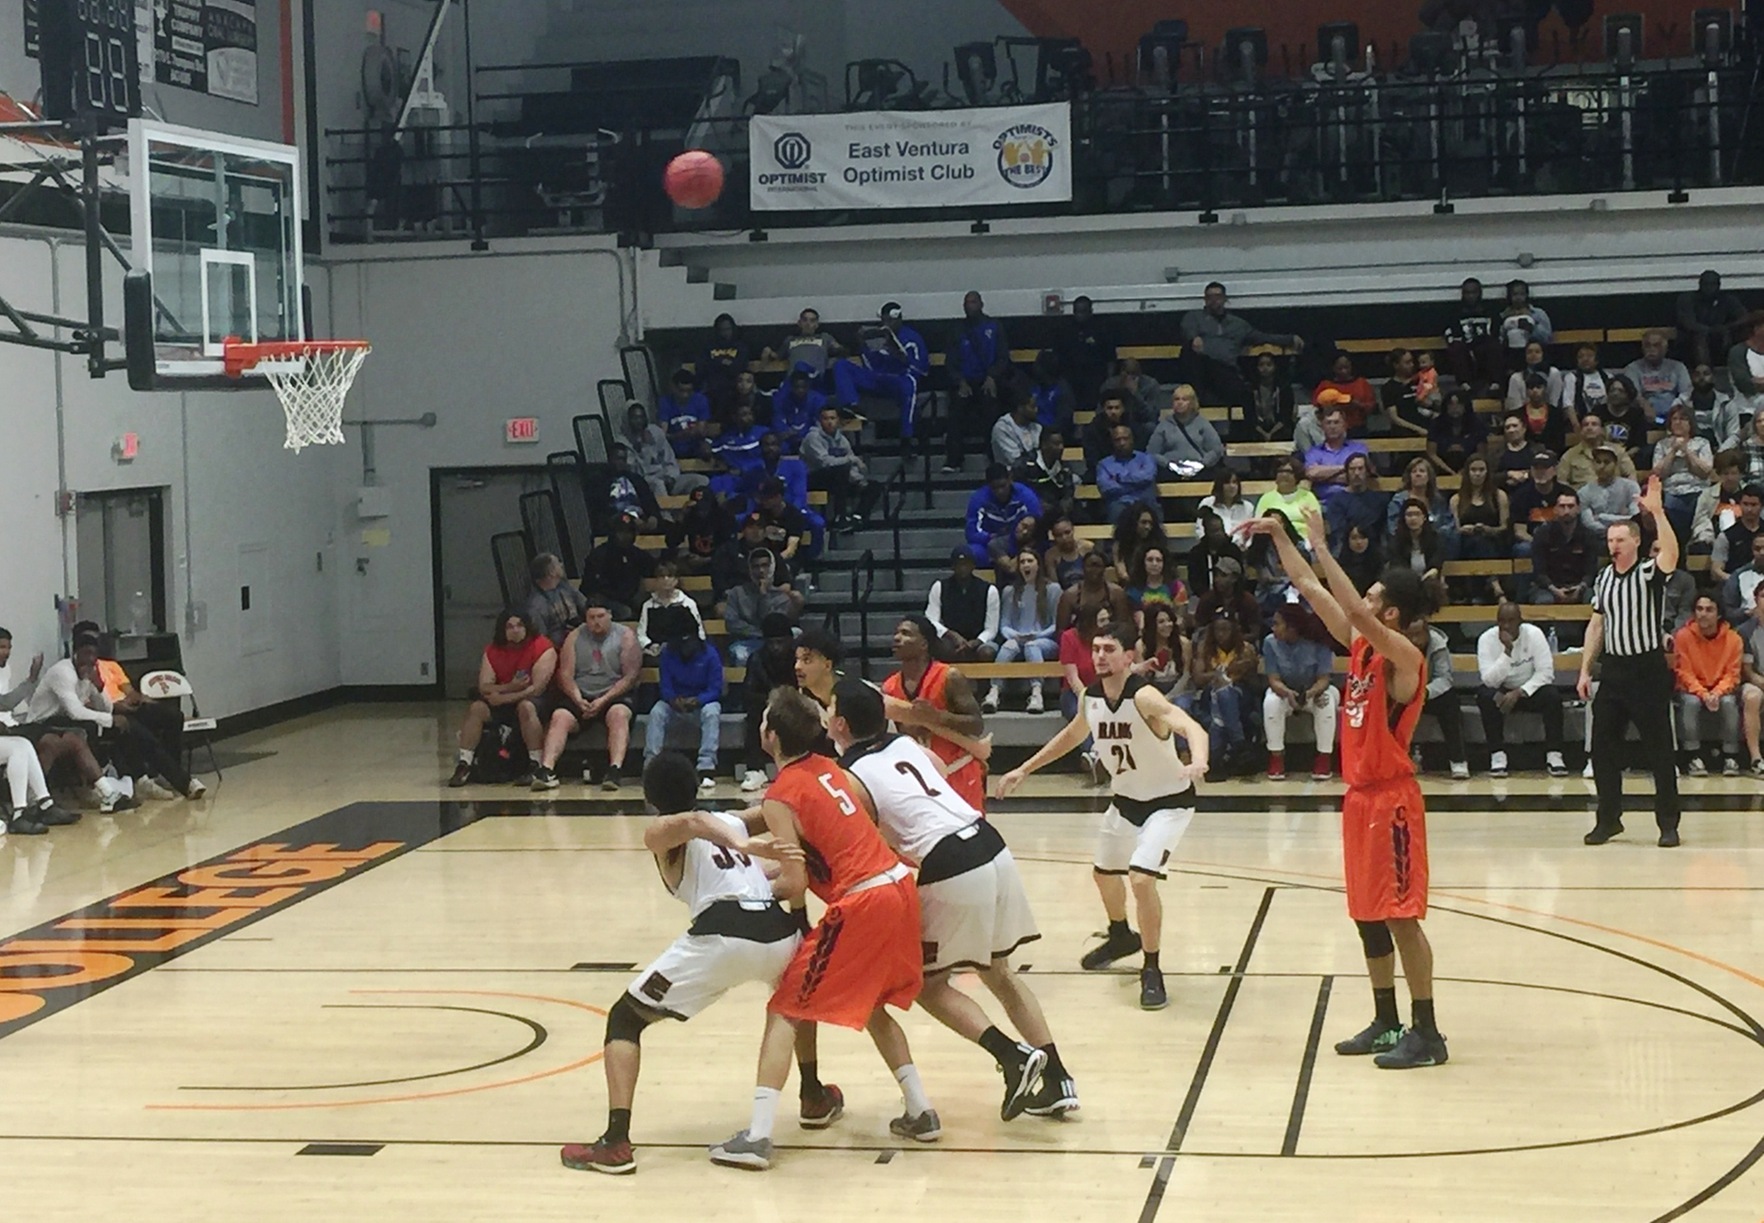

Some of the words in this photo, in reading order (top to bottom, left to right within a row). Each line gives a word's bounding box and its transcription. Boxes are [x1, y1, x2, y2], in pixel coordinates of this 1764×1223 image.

[848, 142, 891, 159] East
[896, 141, 969, 157] Ventura
[992, 124, 1058, 150] OPTIMISTS
[758, 172, 827, 185] OPTIMIST
[843, 166, 925, 186] Optimist
[931, 164, 975, 180] Club
[511, 420, 534, 439] EXIT
[1111, 744, 1137, 775] 21
[893, 761, 940, 797] 2
[817, 772, 857, 816] 5
[0, 841, 406, 1023] OLLEGE
